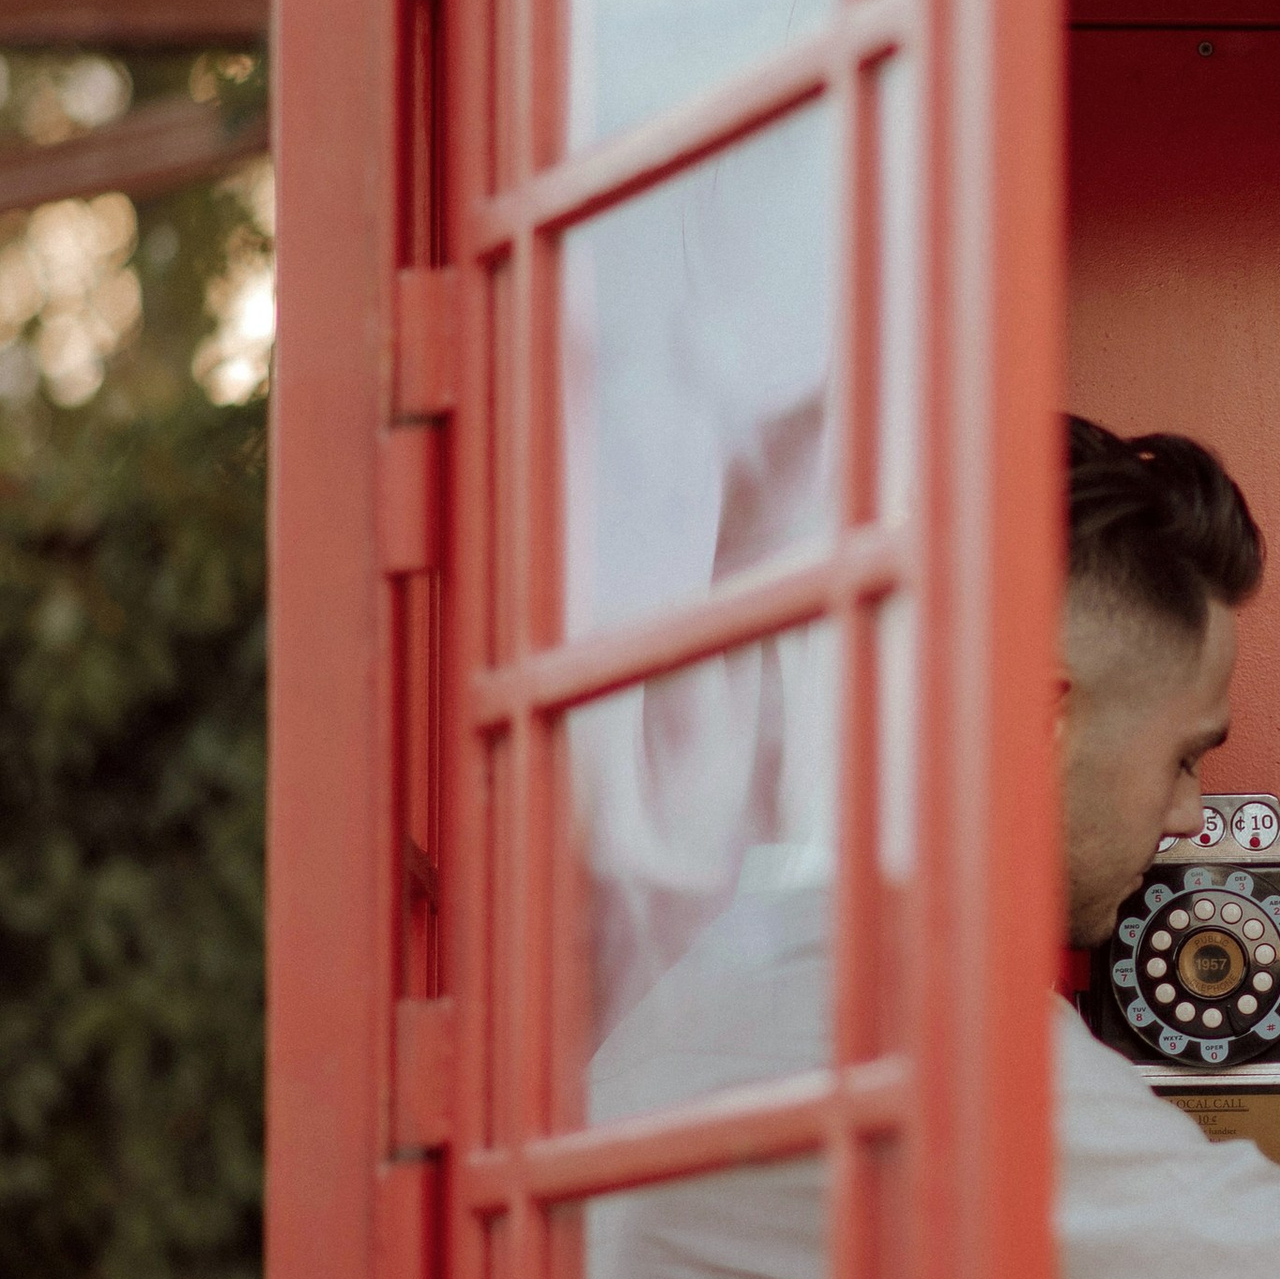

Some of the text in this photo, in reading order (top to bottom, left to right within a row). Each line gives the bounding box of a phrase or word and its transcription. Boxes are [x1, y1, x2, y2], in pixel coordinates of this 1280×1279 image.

[1206, 815, 1218, 831] 5
[1251, 814, 1273, 831] 10
[1194, 878, 1202, 886] 4
[1239, 883, 1246, 891] 3
[1155, 894, 1162, 903] 5
[1273, 907, 1280, 916] 2
[1129, 930, 1136, 938] 6
[1194, 935, 1229, 949] PUBLIC
[1195, 958, 1228, 971] 1957
[1121, 974, 1128, 982] 7
[1136, 1013, 1143, 1022] 8
[1169, 1042, 1176, 1050] 9
[1211, 1051, 1218, 1060] 0
[1169, 1098, 1248, 1109] OCAL CALL
[1198, 1114, 1209, 1124] 10
[1208, 1126, 1237, 1135] handset
